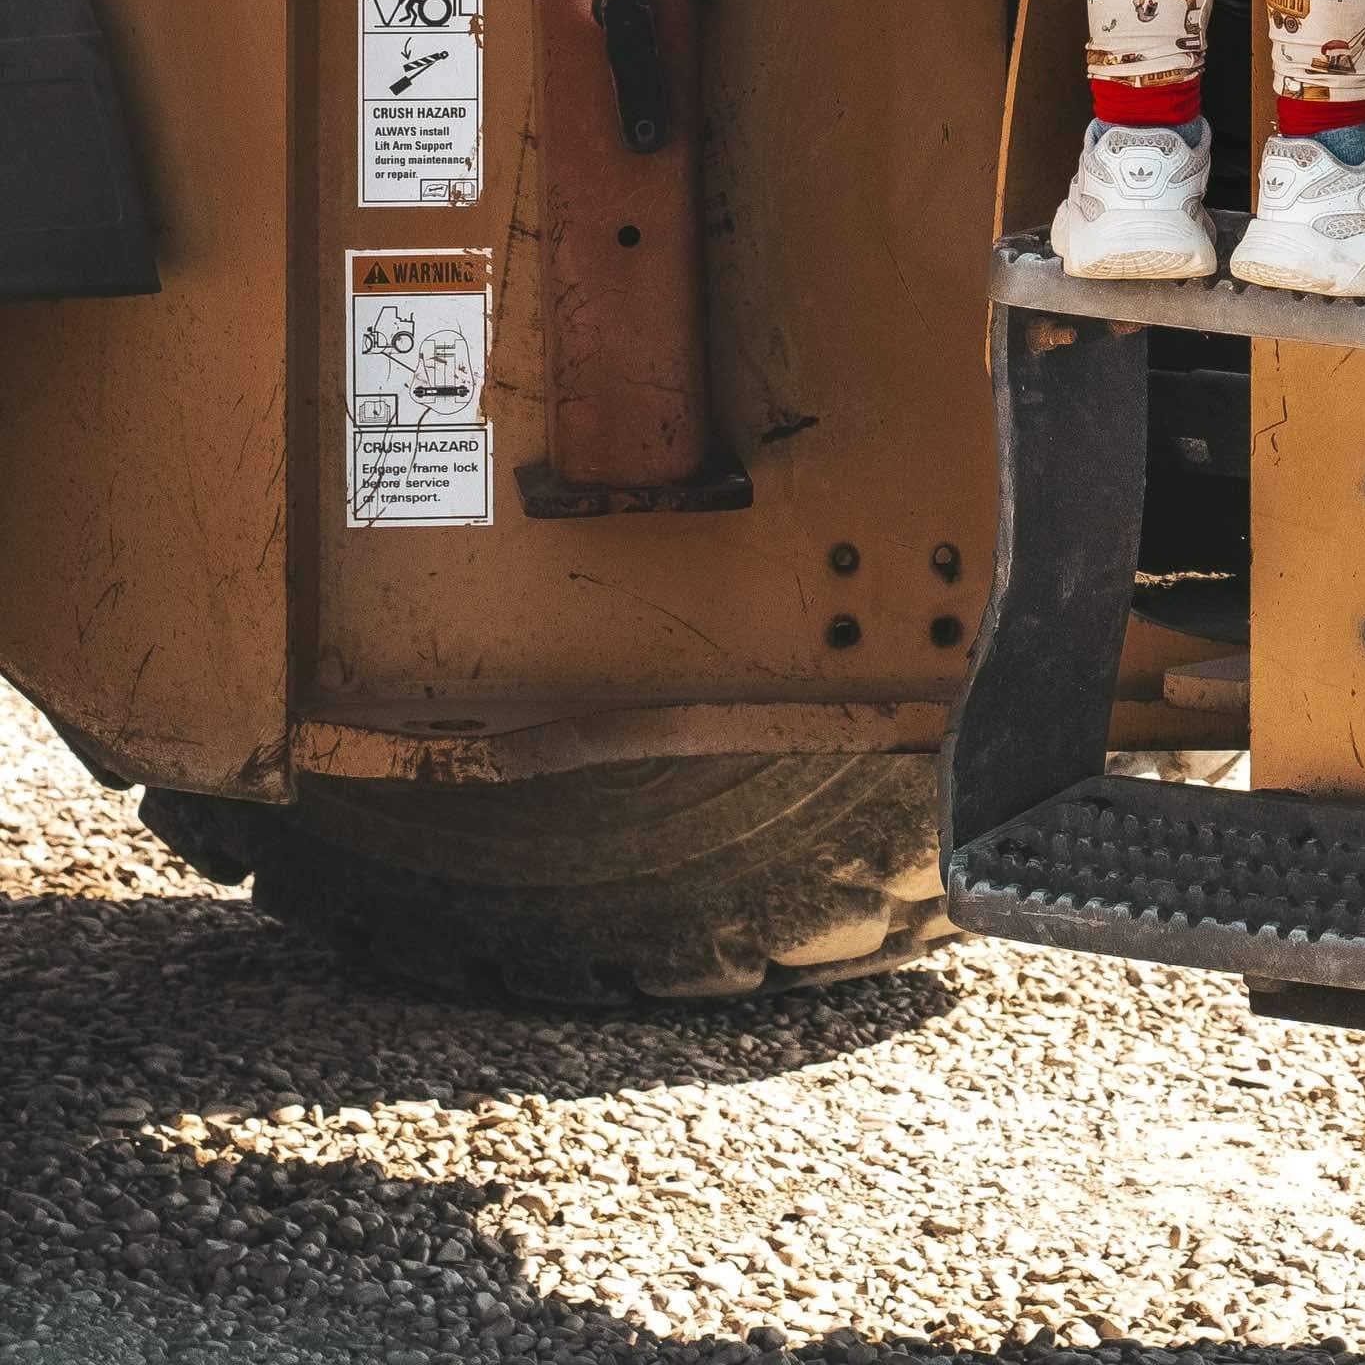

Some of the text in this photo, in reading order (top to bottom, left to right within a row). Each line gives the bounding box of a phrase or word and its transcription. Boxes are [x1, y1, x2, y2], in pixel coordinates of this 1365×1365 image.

[373, 107, 467, 119] CRUSH HAZARD
[374, 126, 450, 137] ALWAYS install
[375, 140, 453, 153] Lift Arm Support
[375, 155, 406, 167] during
[375, 169, 419, 181] or repair.
[393, 260, 475, 284] WARNING
[363, 440, 479, 454] CRUSH HAZARD
[362, 462, 479, 476] Engage frame lock
[361, 478, 450, 489] before service
[362, 493, 441, 505] or transport.
